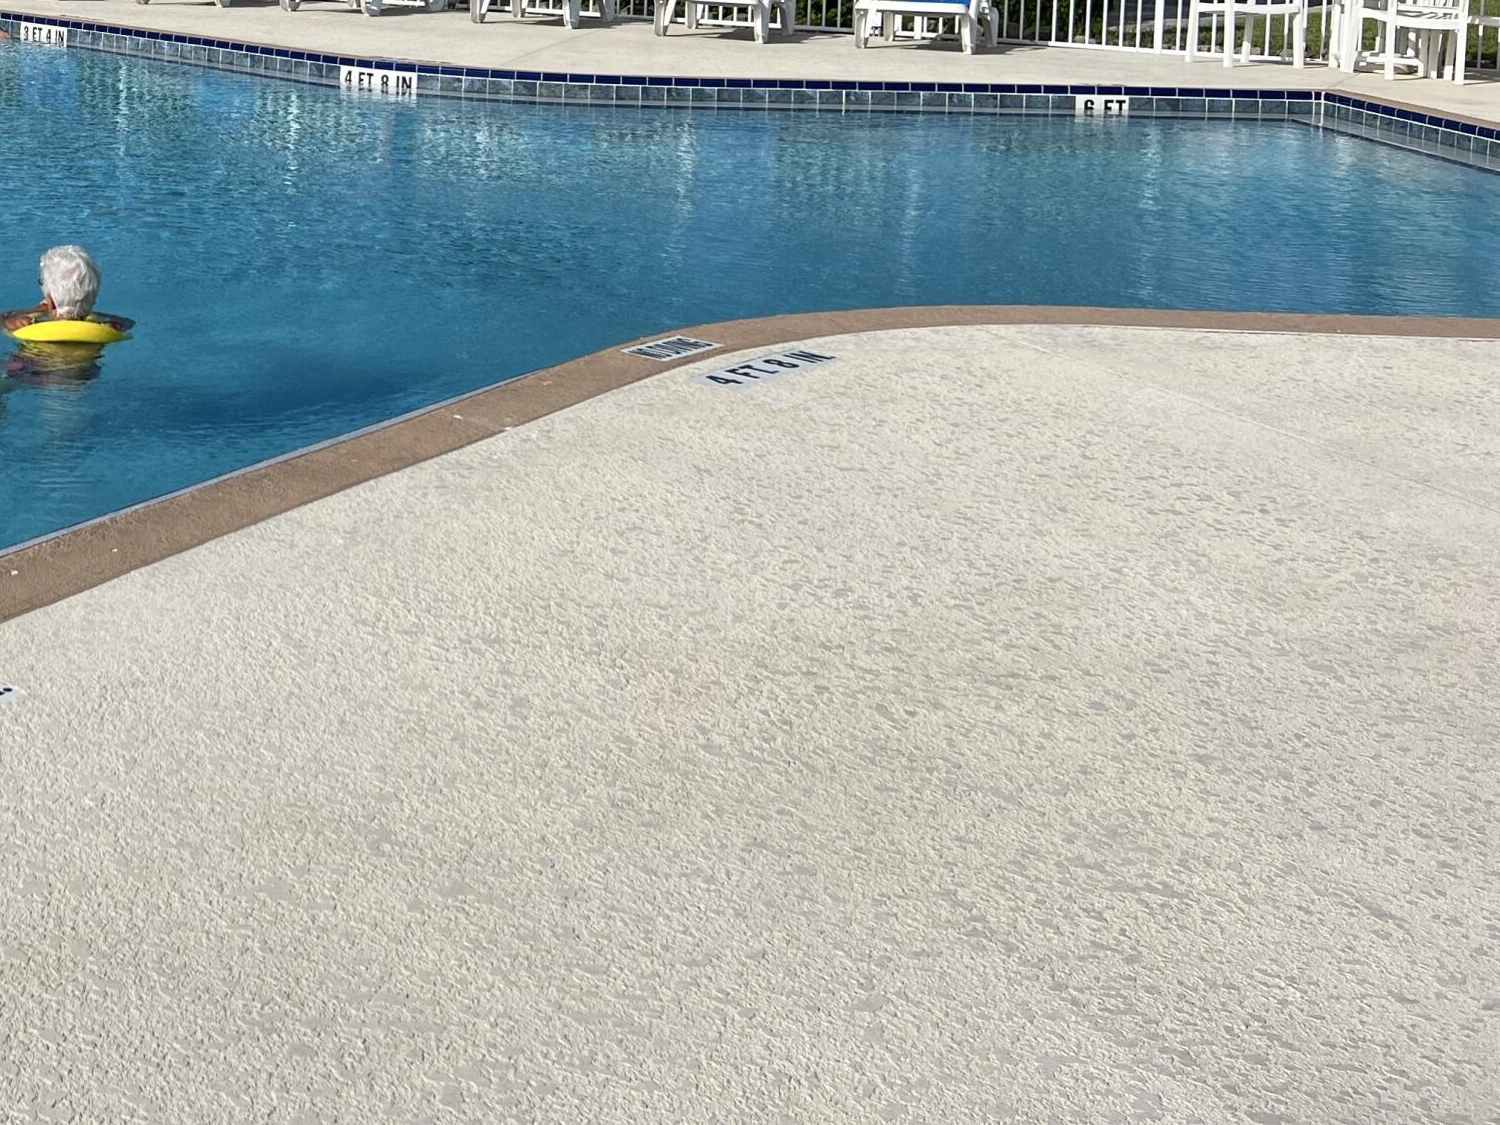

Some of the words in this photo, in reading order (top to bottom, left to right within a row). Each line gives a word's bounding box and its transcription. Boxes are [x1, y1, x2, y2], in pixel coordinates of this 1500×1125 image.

[23, 25, 29, 41] 3
[55, 29, 65, 46] IN
[344, 70, 352, 84] 4
[358, 72, 374, 85] FT
[381, 74, 389, 87] 8
[396, 75, 412, 89] IN
[1104, 100, 1126, 113] FT
[706, 375, 744, 384] 4
[762, 358, 800, 369] 8
